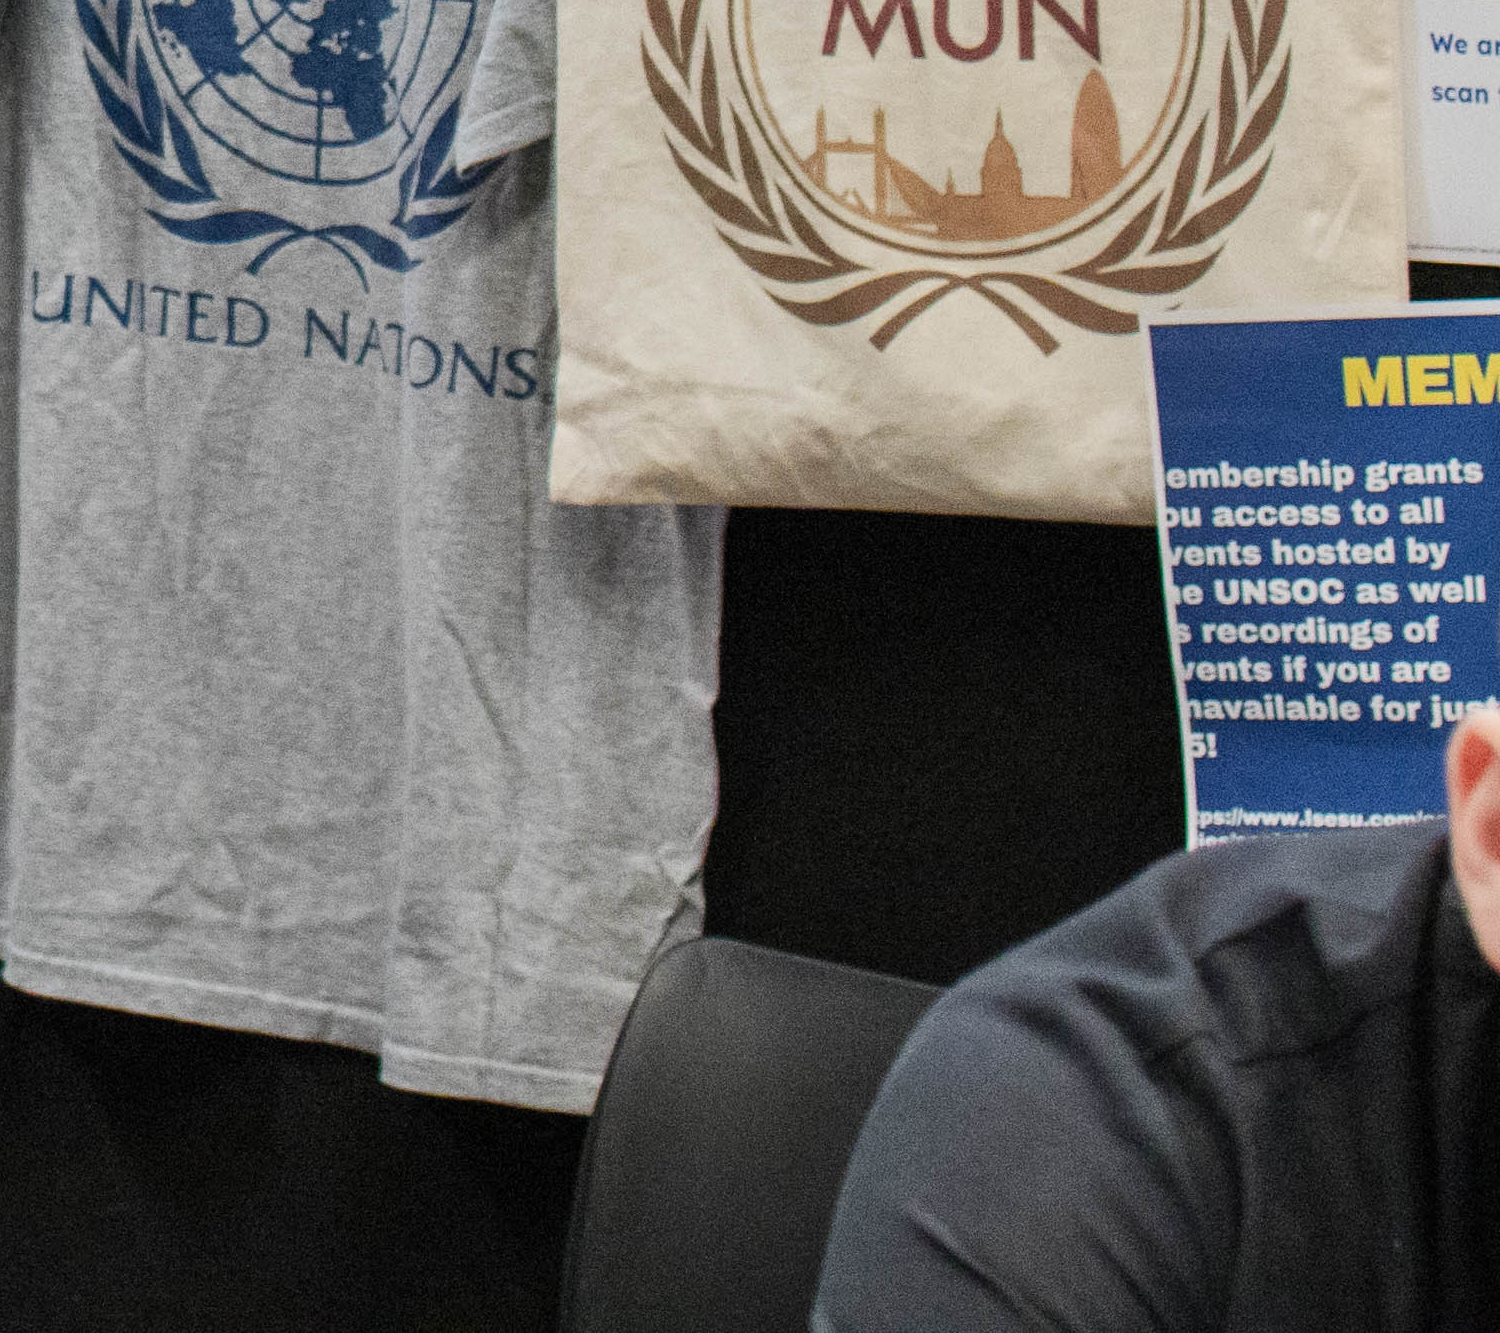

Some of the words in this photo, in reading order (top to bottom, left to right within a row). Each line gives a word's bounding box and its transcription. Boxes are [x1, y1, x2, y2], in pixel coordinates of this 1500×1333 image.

[1430, 31, 1468, 55] We
[1431, 85, 1489, 105] scan
[31, 269, 271, 350] UNITED
[1363, 457, 1485, 493] grants
[1211, 503, 1342, 528] access
[1351, 498, 1390, 526] to
[1399, 495, 1446, 525] all
[1271, 535, 1397, 566] hosted
[1406, 535, 1451, 571] by
[1213, 577, 1346, 606] UNSOC
[1355, 581, 1400, 605] as
[1407, 574, 1488, 604] well
[1201, 616, 1394, 651] recordings
[1403, 613, 1441, 645] of
[1281, 654, 1308, 683] if
[1315, 659, 1381, 690] you
[1390, 659, 1453, 684] are
[1369, 693, 1423, 723] for
